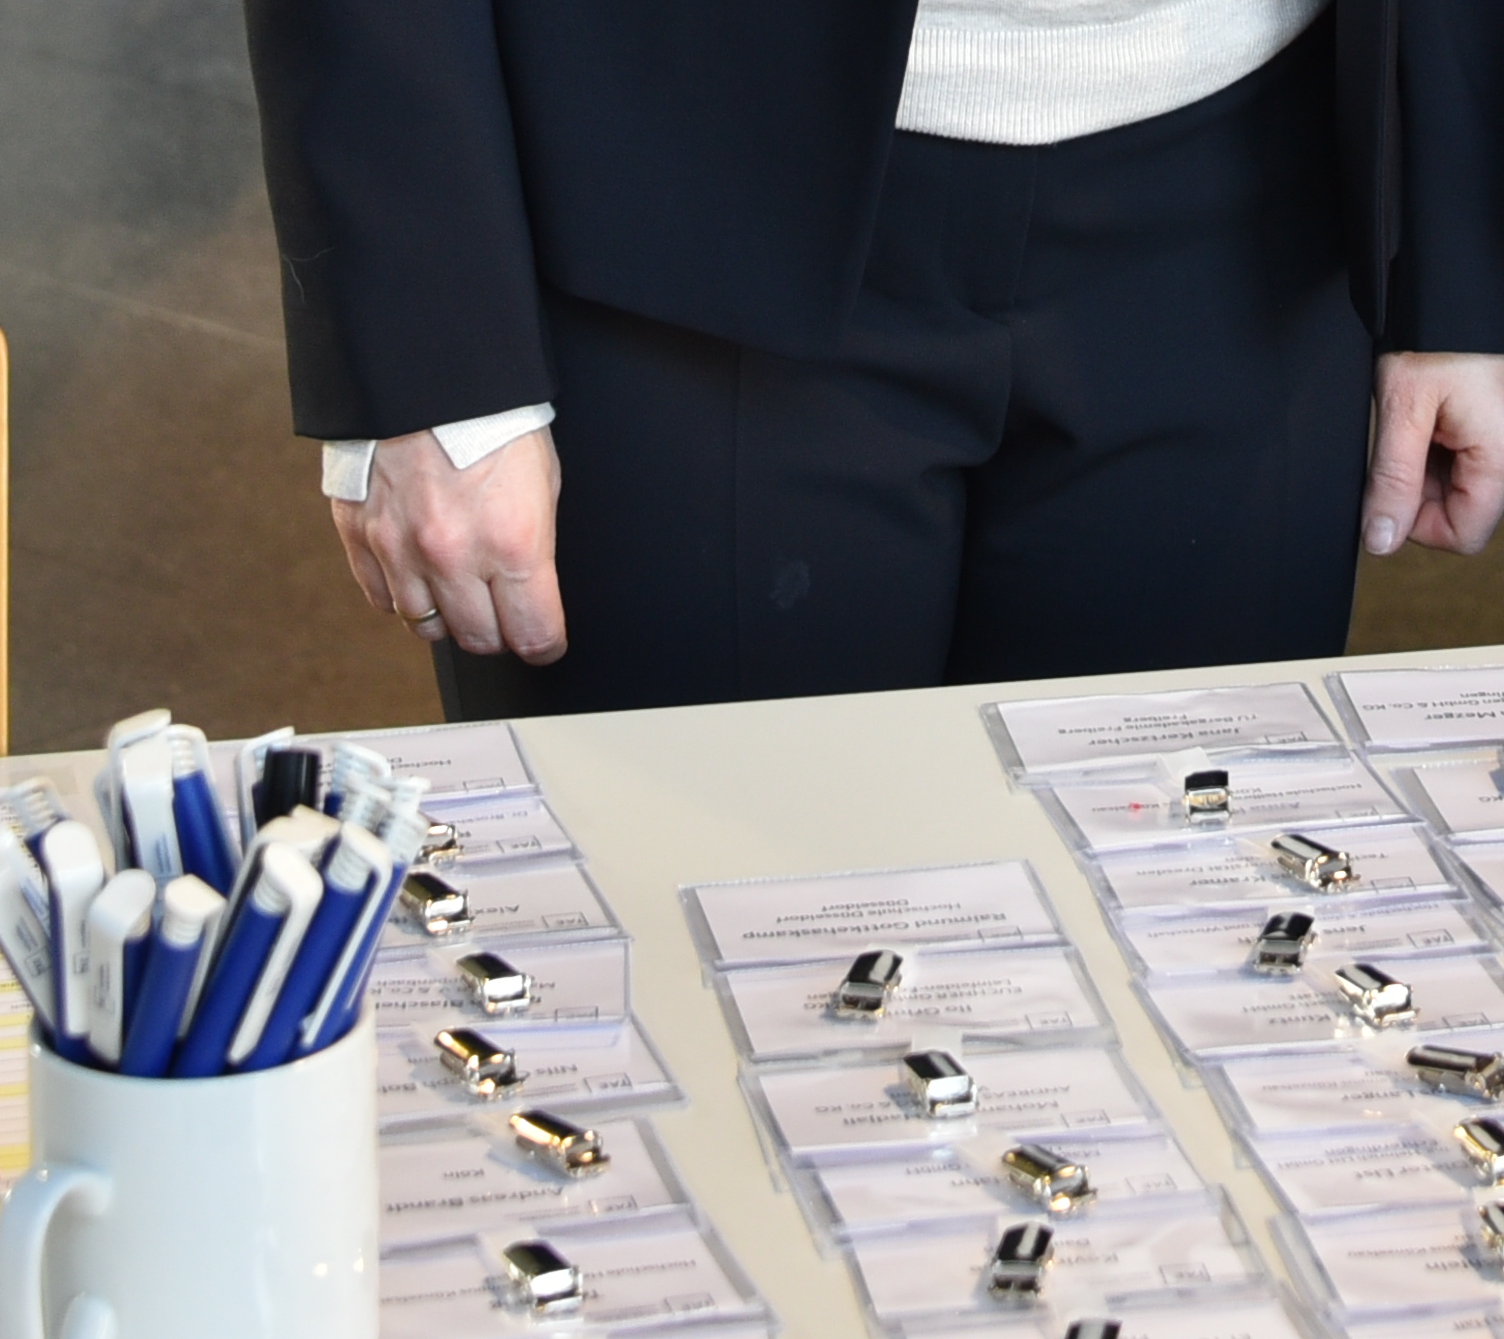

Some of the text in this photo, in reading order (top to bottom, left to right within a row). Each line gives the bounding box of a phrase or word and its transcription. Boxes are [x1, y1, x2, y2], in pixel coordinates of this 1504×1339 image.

[1431, 700, 1481, 709] GmbH
[1425, 713, 1495, 723] Mezger
[1198, 727, 1241, 738] Jana
[1191, 872, 1265, 886] Kramer
[820, 900, 910, 913] Düsseldorf
[775, 903, 962, 924] Hochschule Düsseldorf
[740, 912, 1007, 941] Raimund Gottkehaskamp
[1322, 924, 1366, 934] Jens
[936, 986, 1024, 1003] EUCHNER
[1267, 1013, 1331, 1027] Kuntz
[535, 1064, 578, 1075] Nils
[1340, 1089, 1414, 1103] Langer
[442, 1168, 484, 1180] Köln
[904, 1163, 962, 1178] GmbH
[1354, 1168, 1392, 1180] List
[385, 1186, 563, 1213] Andreas Brandt
